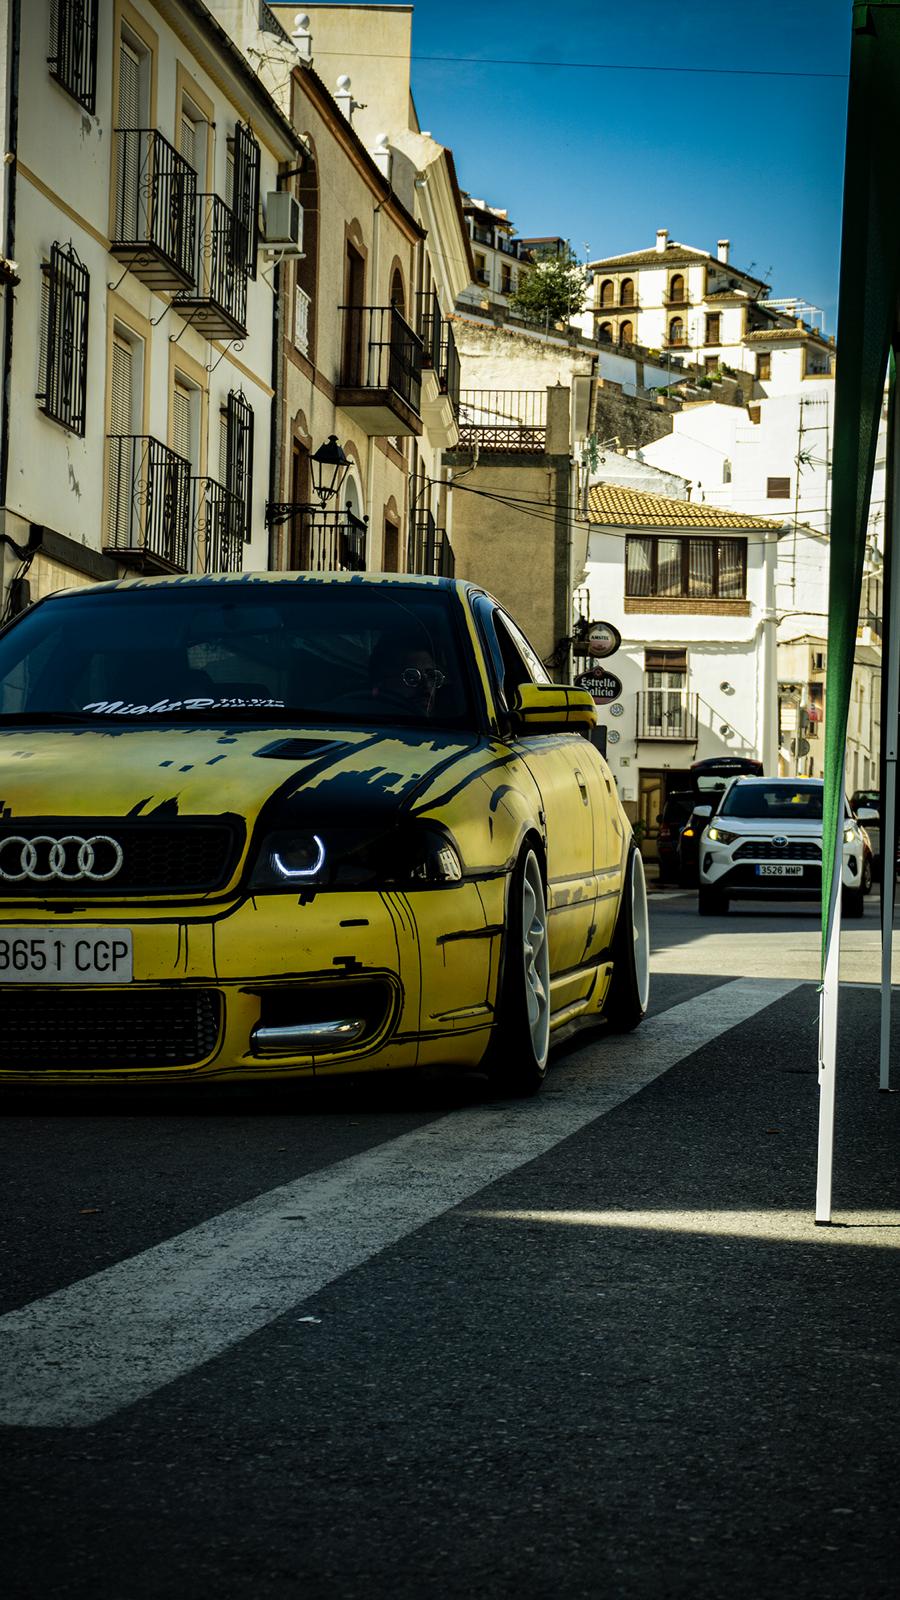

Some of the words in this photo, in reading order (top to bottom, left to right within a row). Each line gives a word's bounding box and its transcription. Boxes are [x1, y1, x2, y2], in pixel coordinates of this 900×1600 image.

[581, 677, 616, 688] Estrella
[761, 866, 783, 875] 3526
[75, 940, 128, 972] CCP
